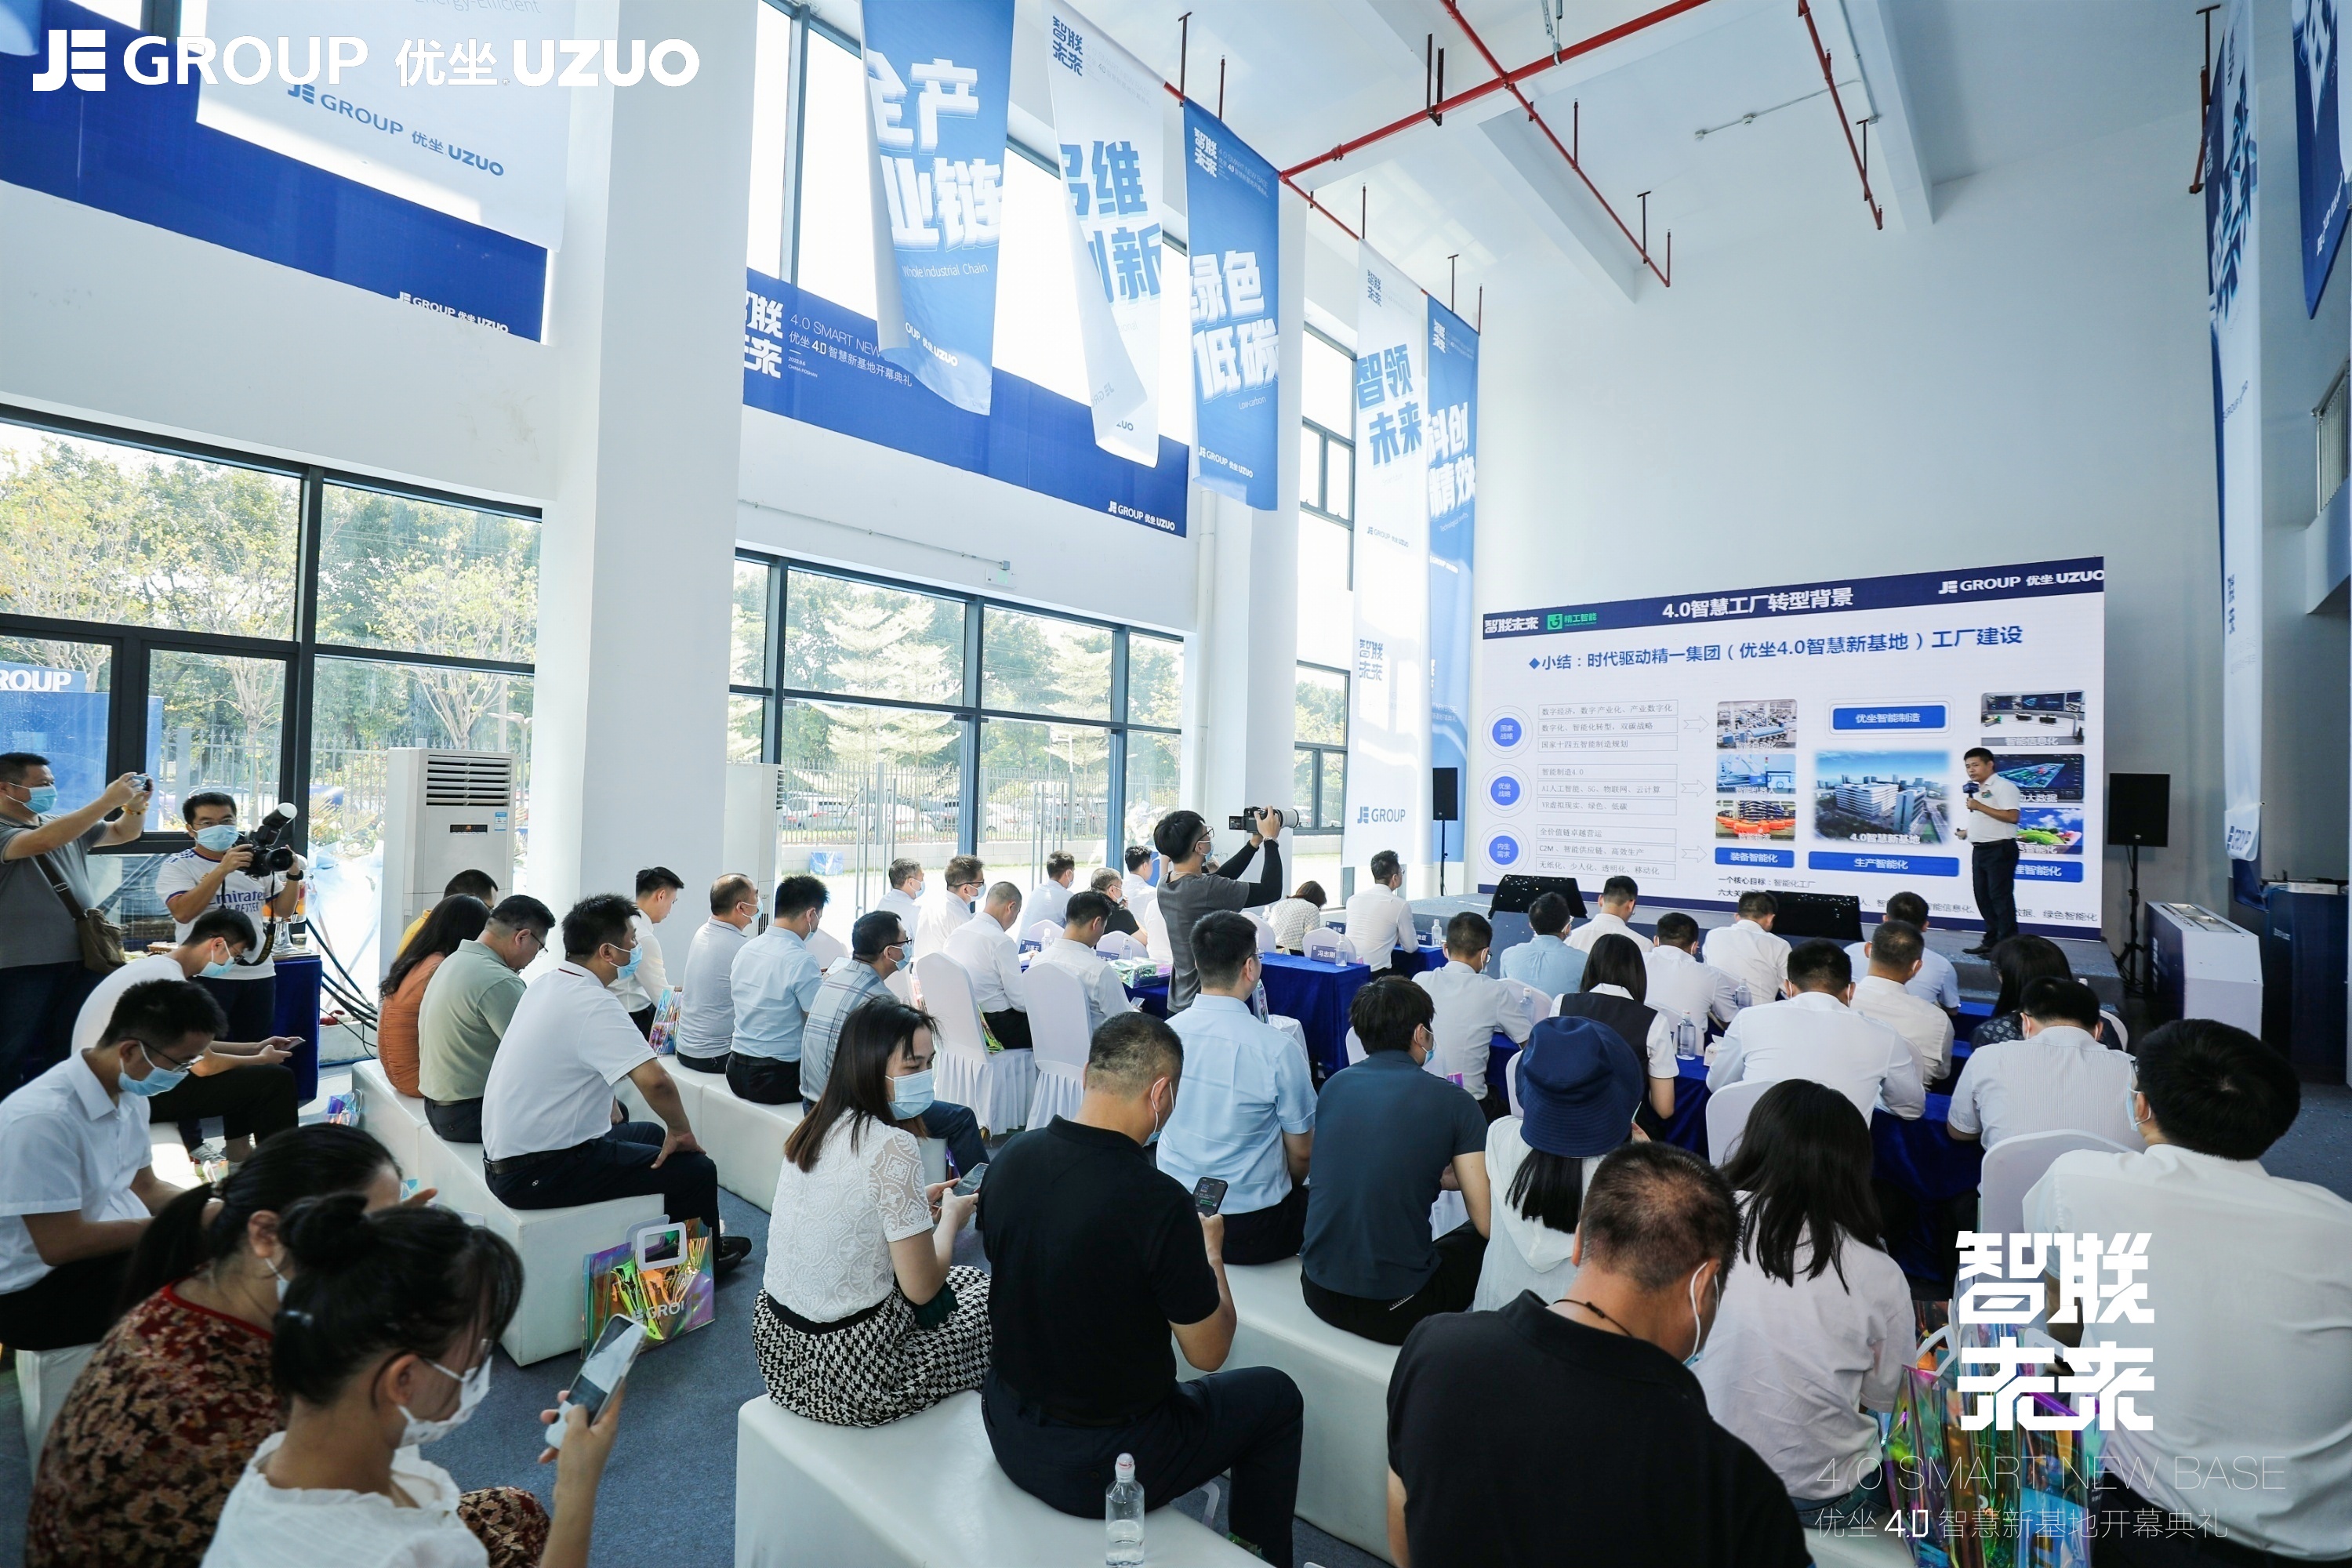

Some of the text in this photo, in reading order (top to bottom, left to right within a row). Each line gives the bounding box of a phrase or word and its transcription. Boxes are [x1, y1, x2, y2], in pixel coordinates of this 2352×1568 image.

[1053, 15, 1083, 55] 智联
[321, 94, 404, 135] GROUP
[412, 130, 445, 154] 优坐
[448, 144, 504, 176] UZUO
[1194, 126, 1218, 160] 智联
[925, 264, 960, 278] Industrial
[963, 263, 989, 275] Chain
[412, 297, 456, 317] GROUP
[477, 316, 509, 333] UZUO
[790, 314, 811, 330] 4.0
[813, 321, 853, 347] SMART
[789, 331, 811, 349] 优坐
[829, 345, 913, 387] 智慧新基地开幕典礼
[933, 346, 958, 367] UZUO
[1193, 318, 1279, 402] 低碳
[1357, 343, 1414, 410] 智领
[1369, 401, 1422, 467] 未来
[1207, 450, 1229, 466] GROUP
[1238, 464, 1254, 478] UZUO
[1118, 504, 1144, 521] GROUP
[1156, 517, 1175, 532] UZUO
[1374, 528, 1391, 539] GROUP
[1960, 576, 2021, 593] GROUP
[2026, 574, 2054, 587] 优坐
[2056, 570, 2105, 584] UZUO
[1662, 587, 1853, 619] 4.0智慧工厂转型背景
[1485, 616, 1539, 634] 智联未来
[1564, 612, 1597, 623] 精工智能
[1855, 713, 1921, 724] 优坐智能制造
[1500, 724, 1513, 733] 国家
[1541, 739, 1628, 750] 国家十四五智能制造规划
[2005, 736, 2059, 746] 智能信息化
[1542, 768, 1584, 777] 智能制造4.0
[1541, 800, 1628, 811] VR虚拟现实、绿色、低碳
[1371, 808, 1406, 822] GROUP
[1540, 827, 1602, 838] 全价值链卓越营运
[1849, 833, 1921, 845] 4.0智慧新基地
[1730, 851, 1778, 864] 装备智能化
[1853, 858, 1909, 870] 生产智能化
[209, 890, 264, 905] mirate
